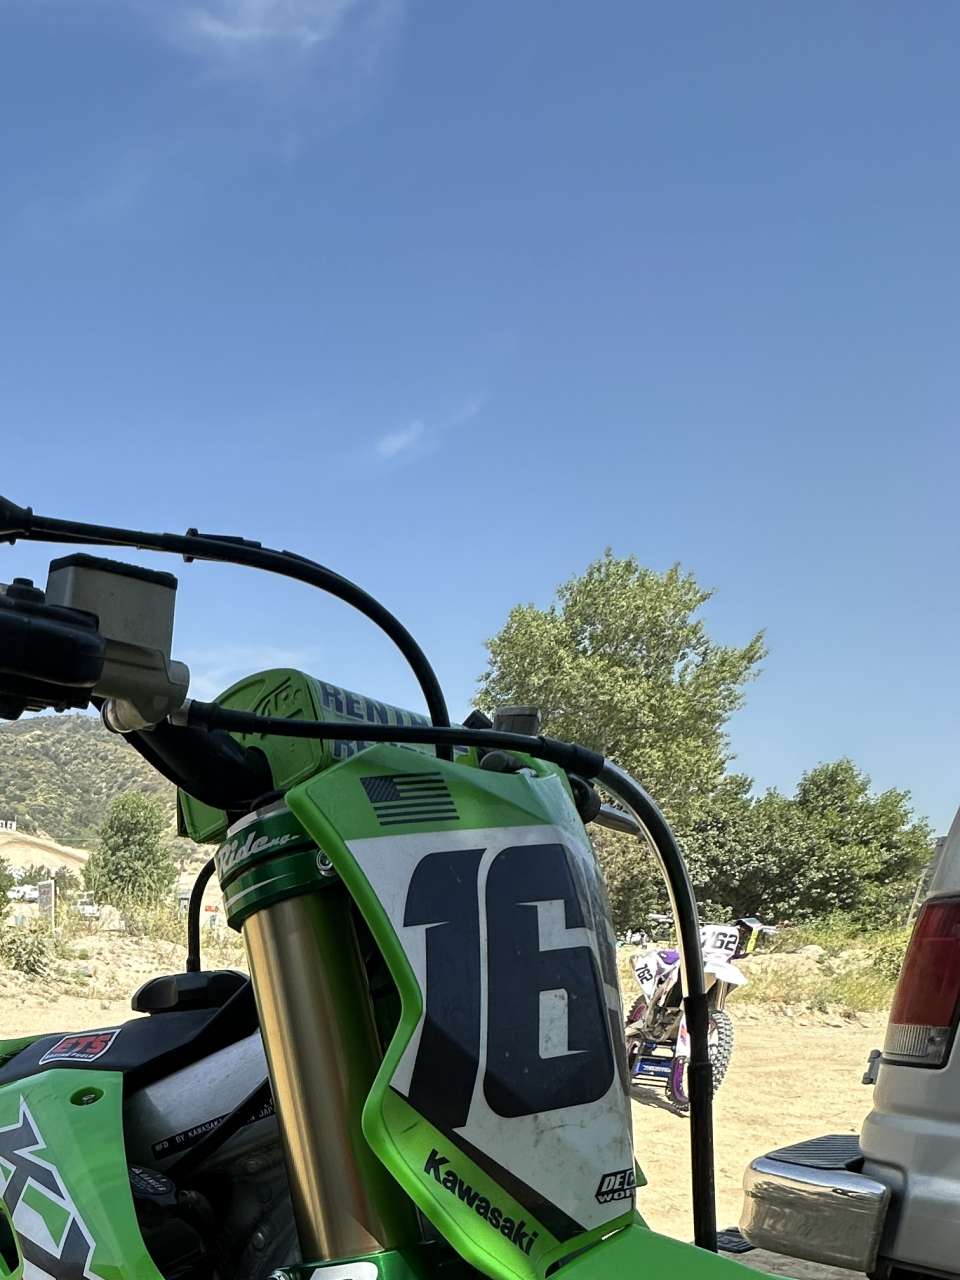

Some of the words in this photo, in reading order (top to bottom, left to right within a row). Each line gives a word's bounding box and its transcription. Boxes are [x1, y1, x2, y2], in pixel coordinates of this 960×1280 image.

[320, 680, 432, 728] RENTH
[404, 843, 632, 1128] 16
[636, 963, 653, 985] 762
[50, 1033, 112, 1055] ETS
[600, 1169, 637, 1192] DEC
[424, 1148, 540, 1257] Kawasaki
